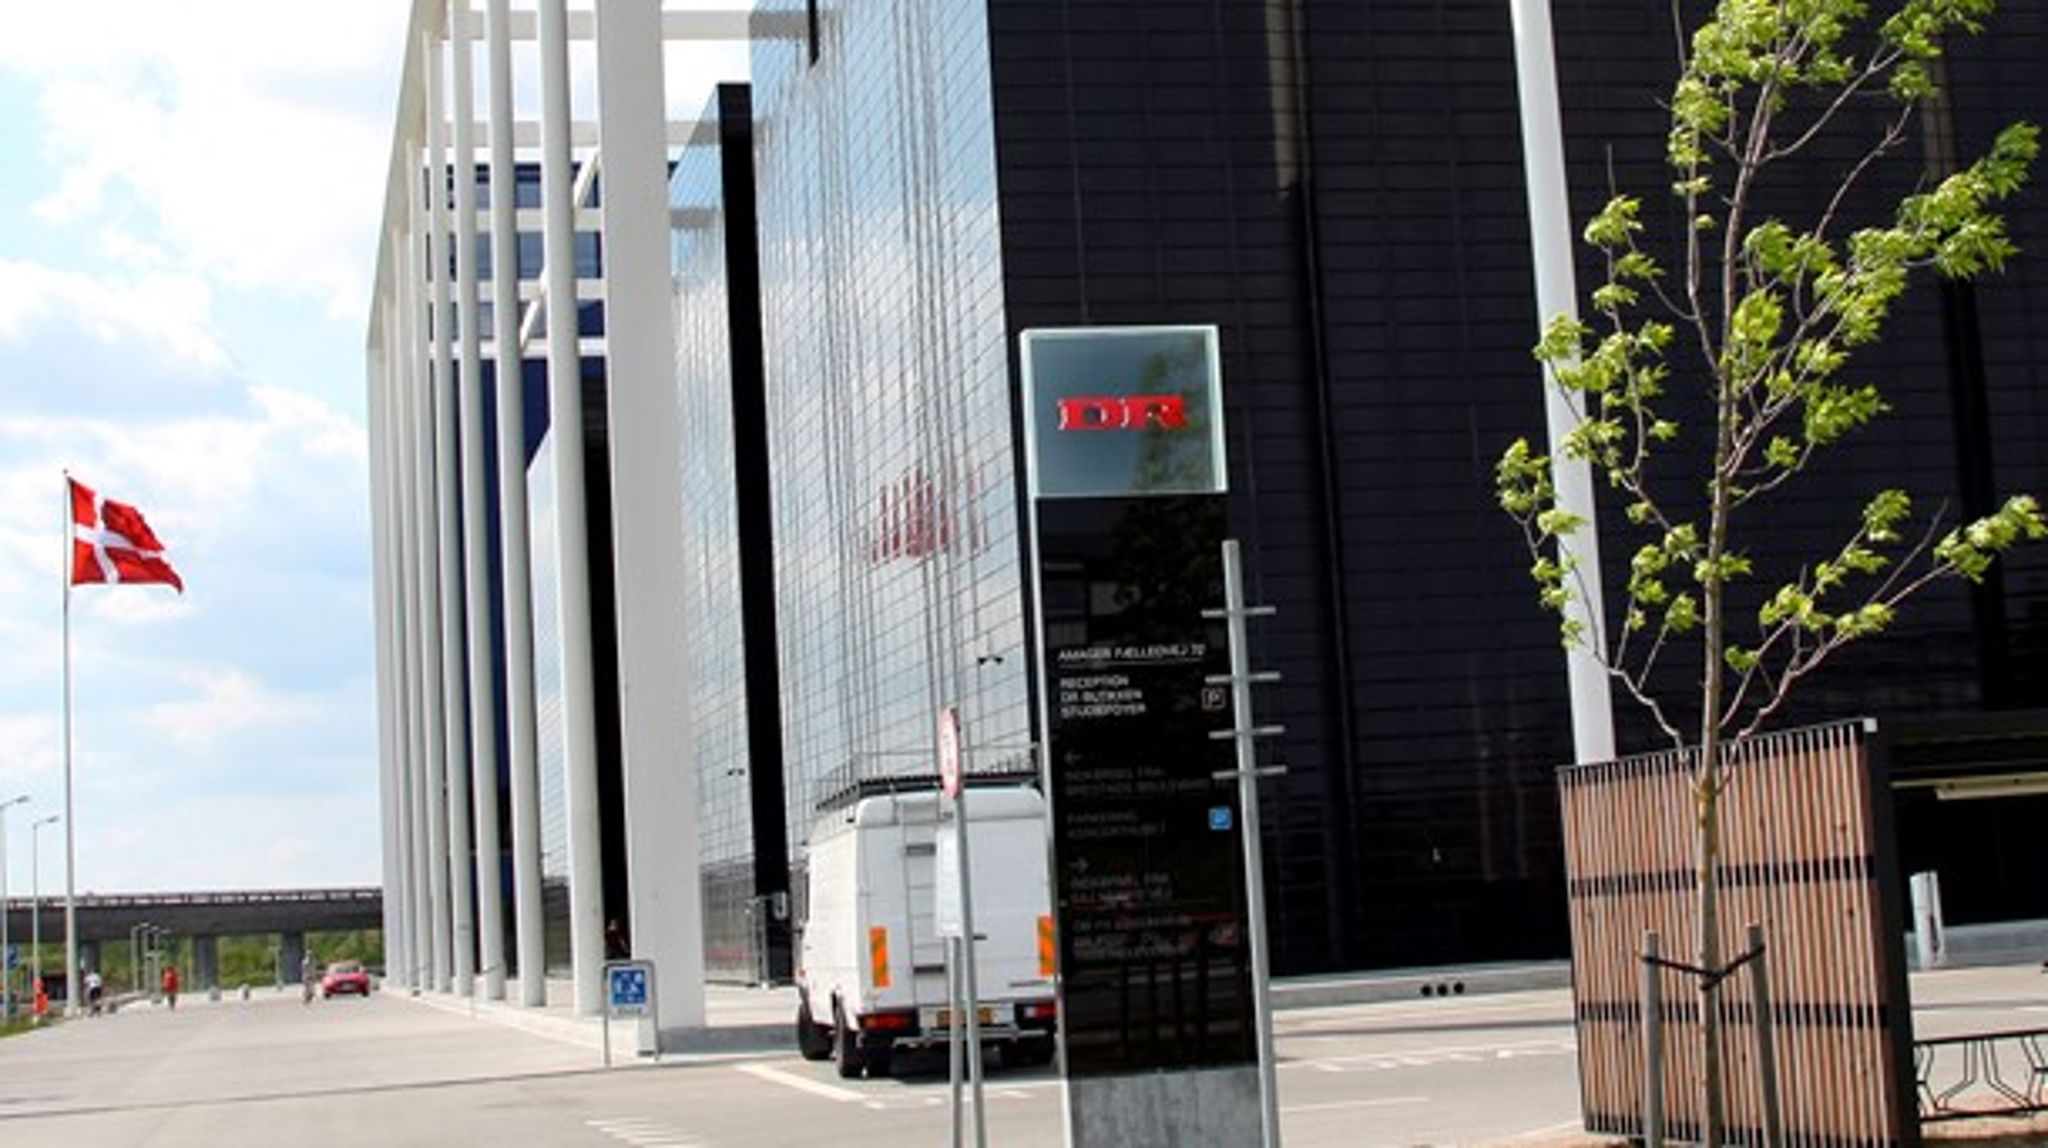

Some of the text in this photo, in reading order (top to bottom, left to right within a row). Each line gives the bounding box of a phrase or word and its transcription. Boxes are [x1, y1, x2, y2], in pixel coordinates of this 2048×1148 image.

[1056, 394, 1187, 431] DR
[1058, 646, 1112, 661] AMAGER
[1059, 675, 1129, 689] RECEPTION
